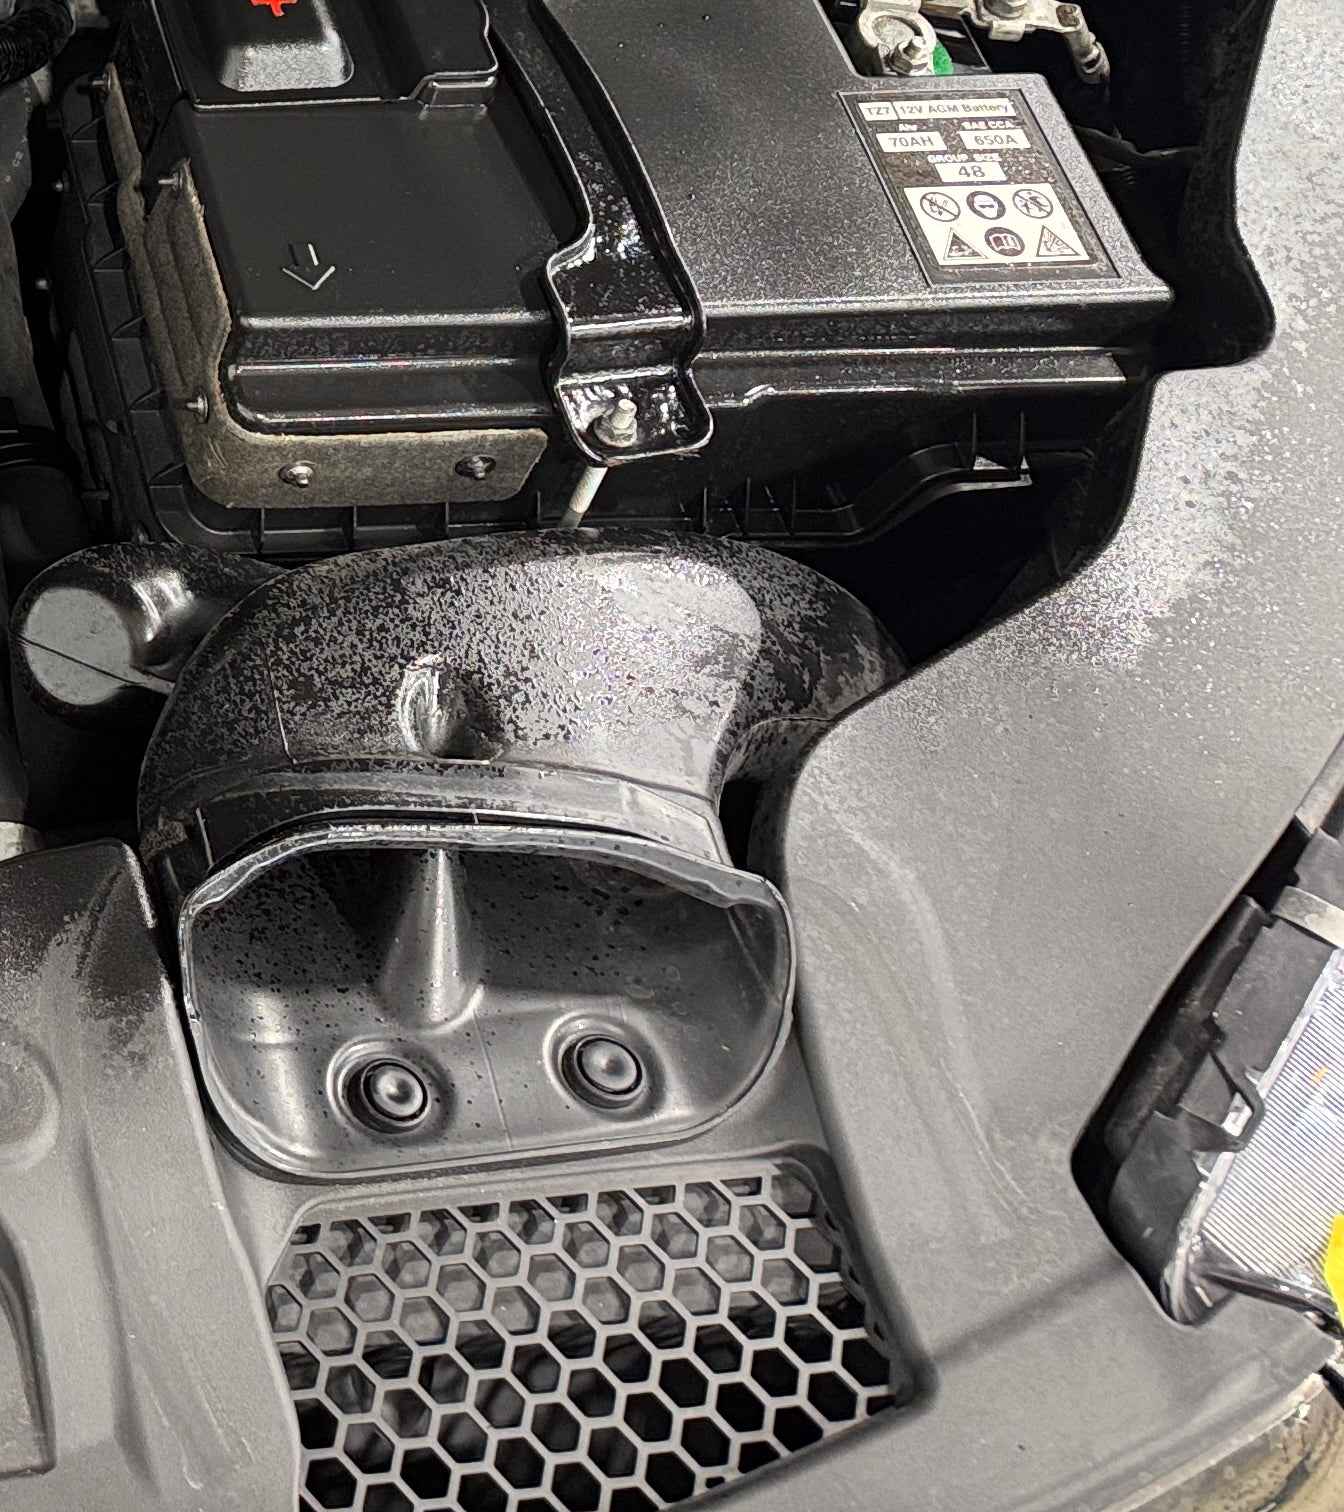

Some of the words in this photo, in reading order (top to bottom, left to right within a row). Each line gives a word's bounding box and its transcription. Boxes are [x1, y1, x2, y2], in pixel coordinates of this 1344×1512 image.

[899, 105, 923, 115] 12V
[928, 104, 959, 114] AGM
[962, 103, 1009, 114] Battery
[988, 120, 1015, 129] CCA
[888, 136, 935, 148] 70AH
[974, 134, 1019, 146] 650A
[927, 154, 968, 164] GROUP
[973, 153, 1002, 162] SIZE
[958, 165, 986, 179] 48
